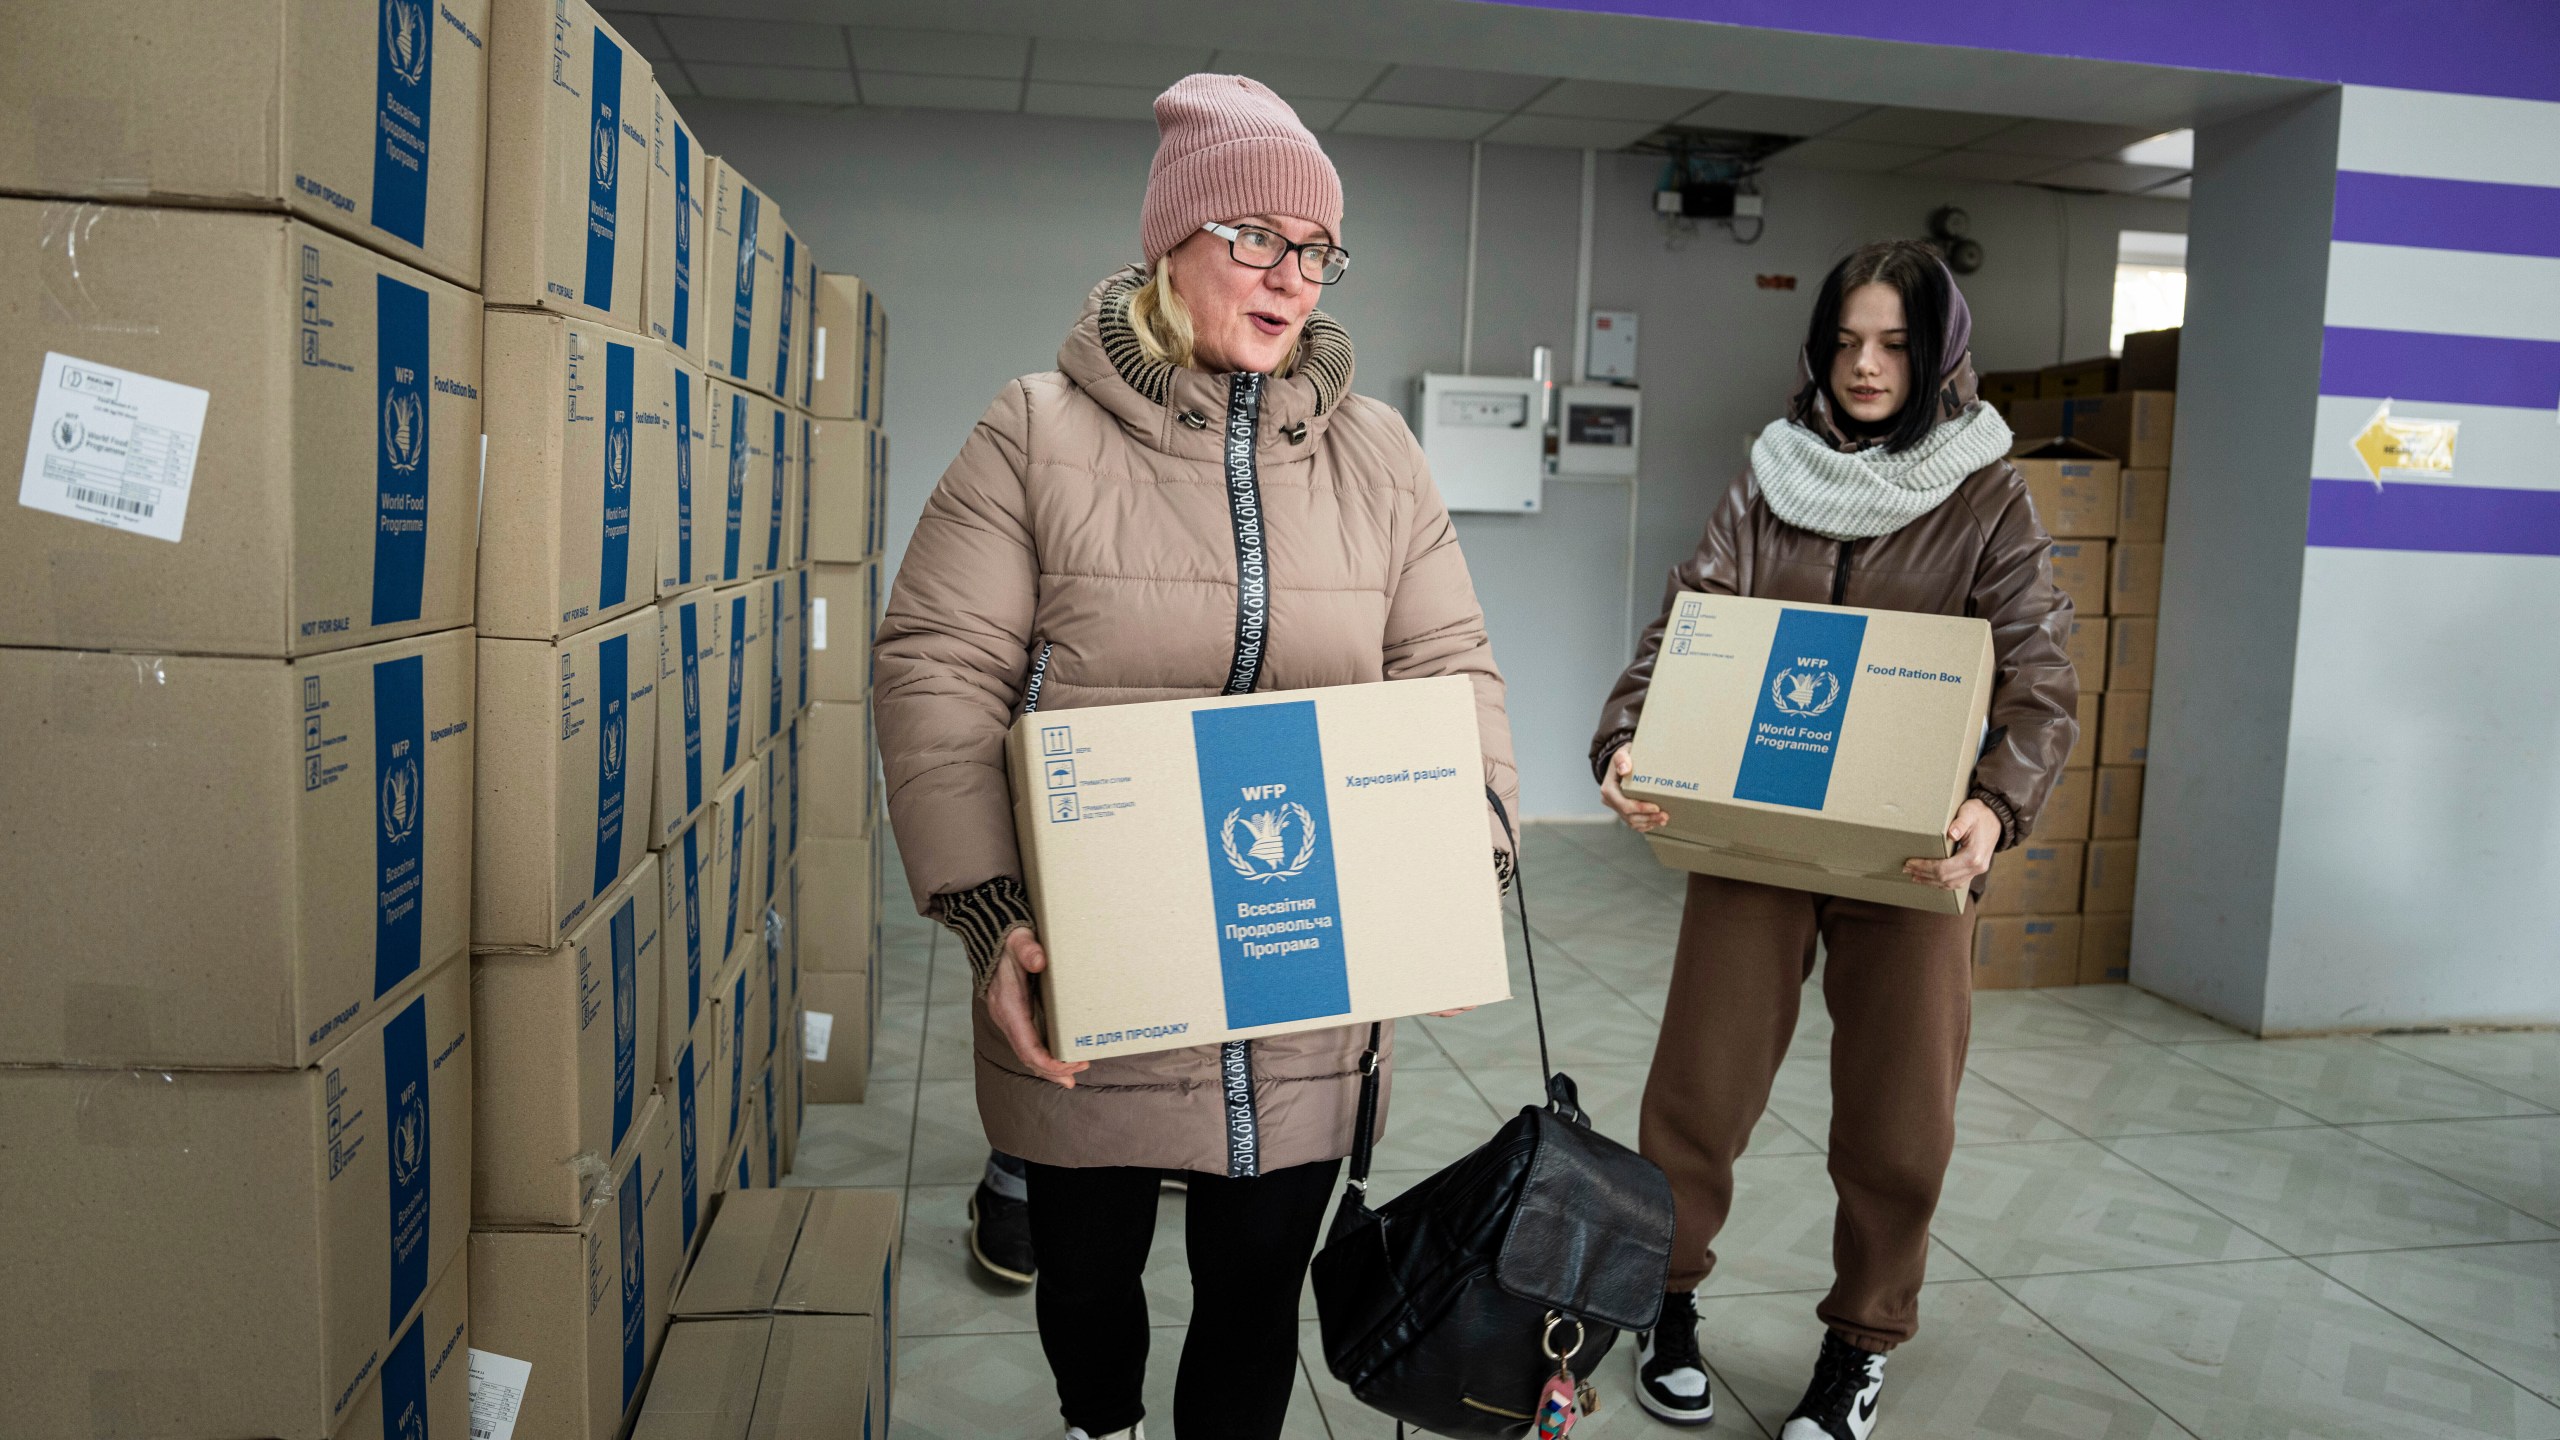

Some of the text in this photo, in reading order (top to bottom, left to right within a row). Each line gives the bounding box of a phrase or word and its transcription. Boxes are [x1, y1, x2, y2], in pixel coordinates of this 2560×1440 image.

[387, 92, 420, 128] Всесвітня
[380, 110, 425, 153] Продовольча
[386, 138, 418, 171] Програма
[591, 200, 614, 224] World Food
[591, 218, 613, 240] Programme
[395, 366, 414, 385] WFP
[434, 376, 478, 400] Food Ration Box
[382, 493, 424, 510] World Food
[606, 506, 628, 521] World Food
[381, 515, 423, 536] Programme
[606, 524, 628, 540] Programme
[302, 617, 350, 637] NOT FOR SALE
[1796, 656, 1828, 669] WFP
[1866, 664, 1962, 684] Food Ration Box
[430, 720, 468, 743] Харчовий раціон
[1758, 722, 1832, 741] World Food
[392, 739, 410, 759] WFP
[1754, 734, 1829, 754] Programme
[1346, 766, 1457, 788] Харчовий раціон
[1632, 774, 1700, 791] NOT FOR SALE
[1241, 782, 1287, 801] WFP
[386, 857, 415, 884] Всесвітня
[380, 874, 420, 909] Продовольча
[386, 898, 414, 926] Програма
[1237, 897, 1316, 918] Всесвітня
[1225, 914, 1332, 942] Продовольча
[1244, 936, 1320, 960] Програма
[1075, 1022, 1189, 1048] НЕ ДЛЯ ПРОДАЖУ
[401, 1081, 416, 1106] WFP
[430, 1322, 464, 1385] Food Ration Box
[398, 1401, 414, 1432] WFP
